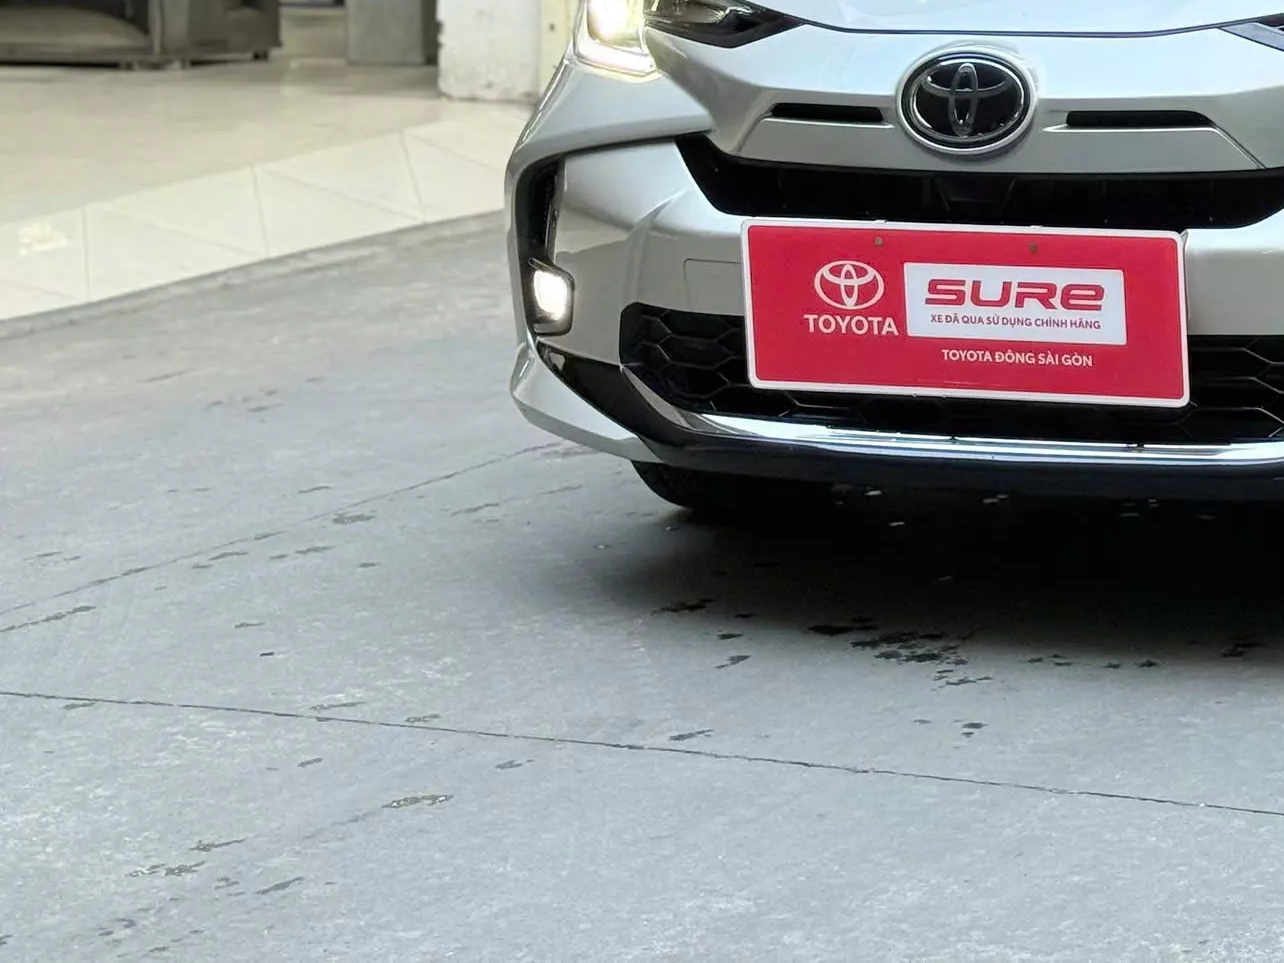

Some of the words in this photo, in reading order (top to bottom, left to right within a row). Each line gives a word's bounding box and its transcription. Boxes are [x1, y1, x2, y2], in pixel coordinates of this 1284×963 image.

[803, 313, 899, 336] TOYOTA
[930, 313, 943, 324] XE
[945, 312, 960, 325] ĐÃ
[961, 315, 985, 326] QUA
[986, 313, 1000, 326] SỬ
[1002, 317, 1033, 329] DỤNG
[1034, 316, 1068, 329] CHÍNH
[1069, 317, 1101, 330] HÃNG
[942, 349, 992, 362] TOYOTA
[995, 348, 1036, 365] ĐÔNG
[1038, 350, 1059, 366] SÀI
[1061, 351, 1093, 367] GÒN
